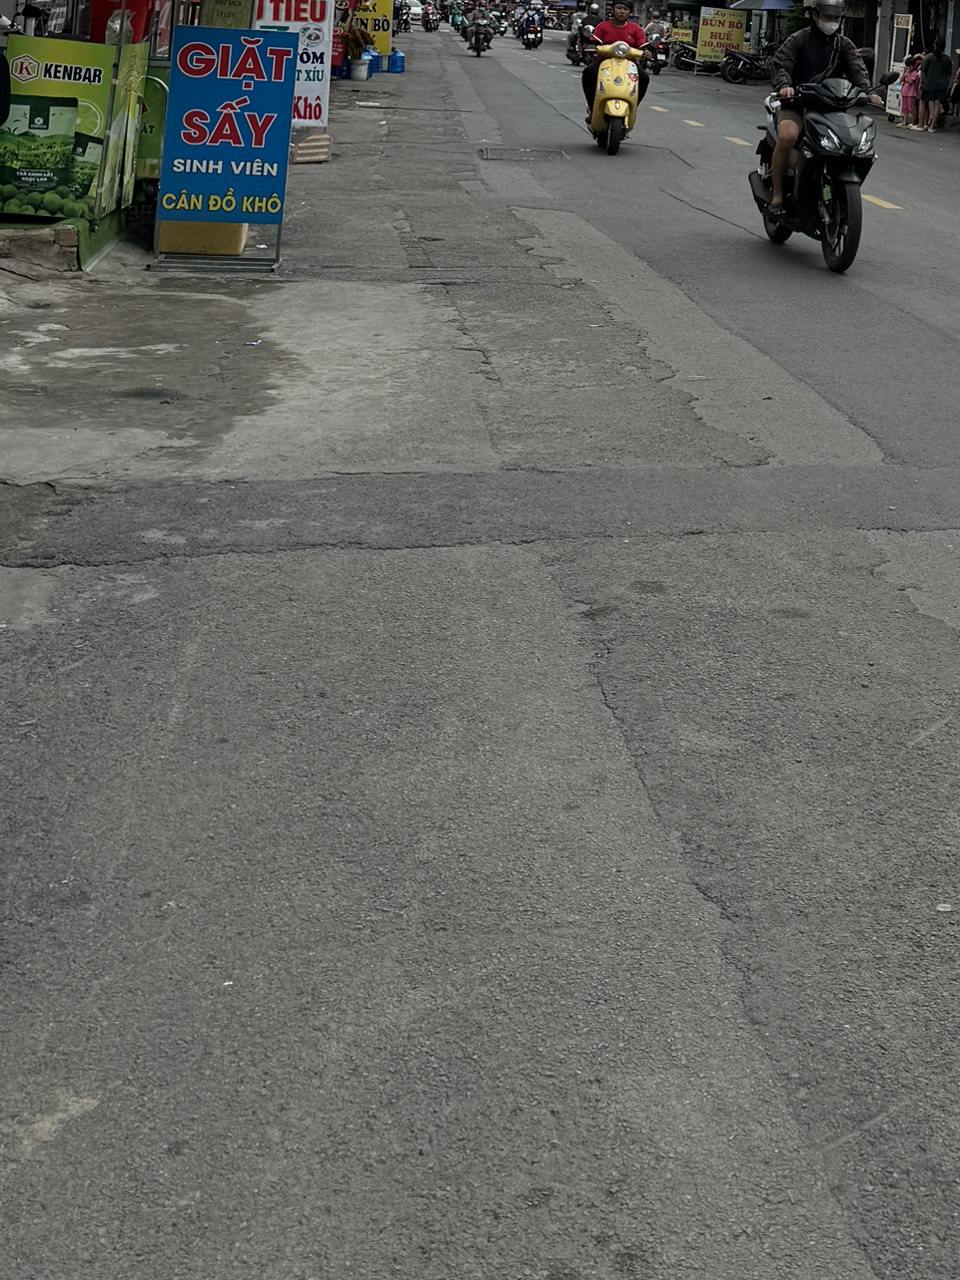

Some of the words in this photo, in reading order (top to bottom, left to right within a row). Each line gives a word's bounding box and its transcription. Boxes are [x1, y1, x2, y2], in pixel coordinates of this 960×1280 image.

[702, 17, 725, 27] BÚN
[710, 30, 733, 41] HUẾ
[177, 36, 293, 90] GIẶT
[297, 48, 324, 65] ÔM
[305, 66, 324, 82] XÍU
[293, 95, 323, 120] Khô
[181, 95, 277, 148] SẤY
[173, 158, 223, 174] SINH
[231, 158, 278, 176] VIÊN
[161, 189, 203, 211] CÂN
[208, 187, 237, 212] ĐỒ
[242, 193, 282, 213] KHÔ
